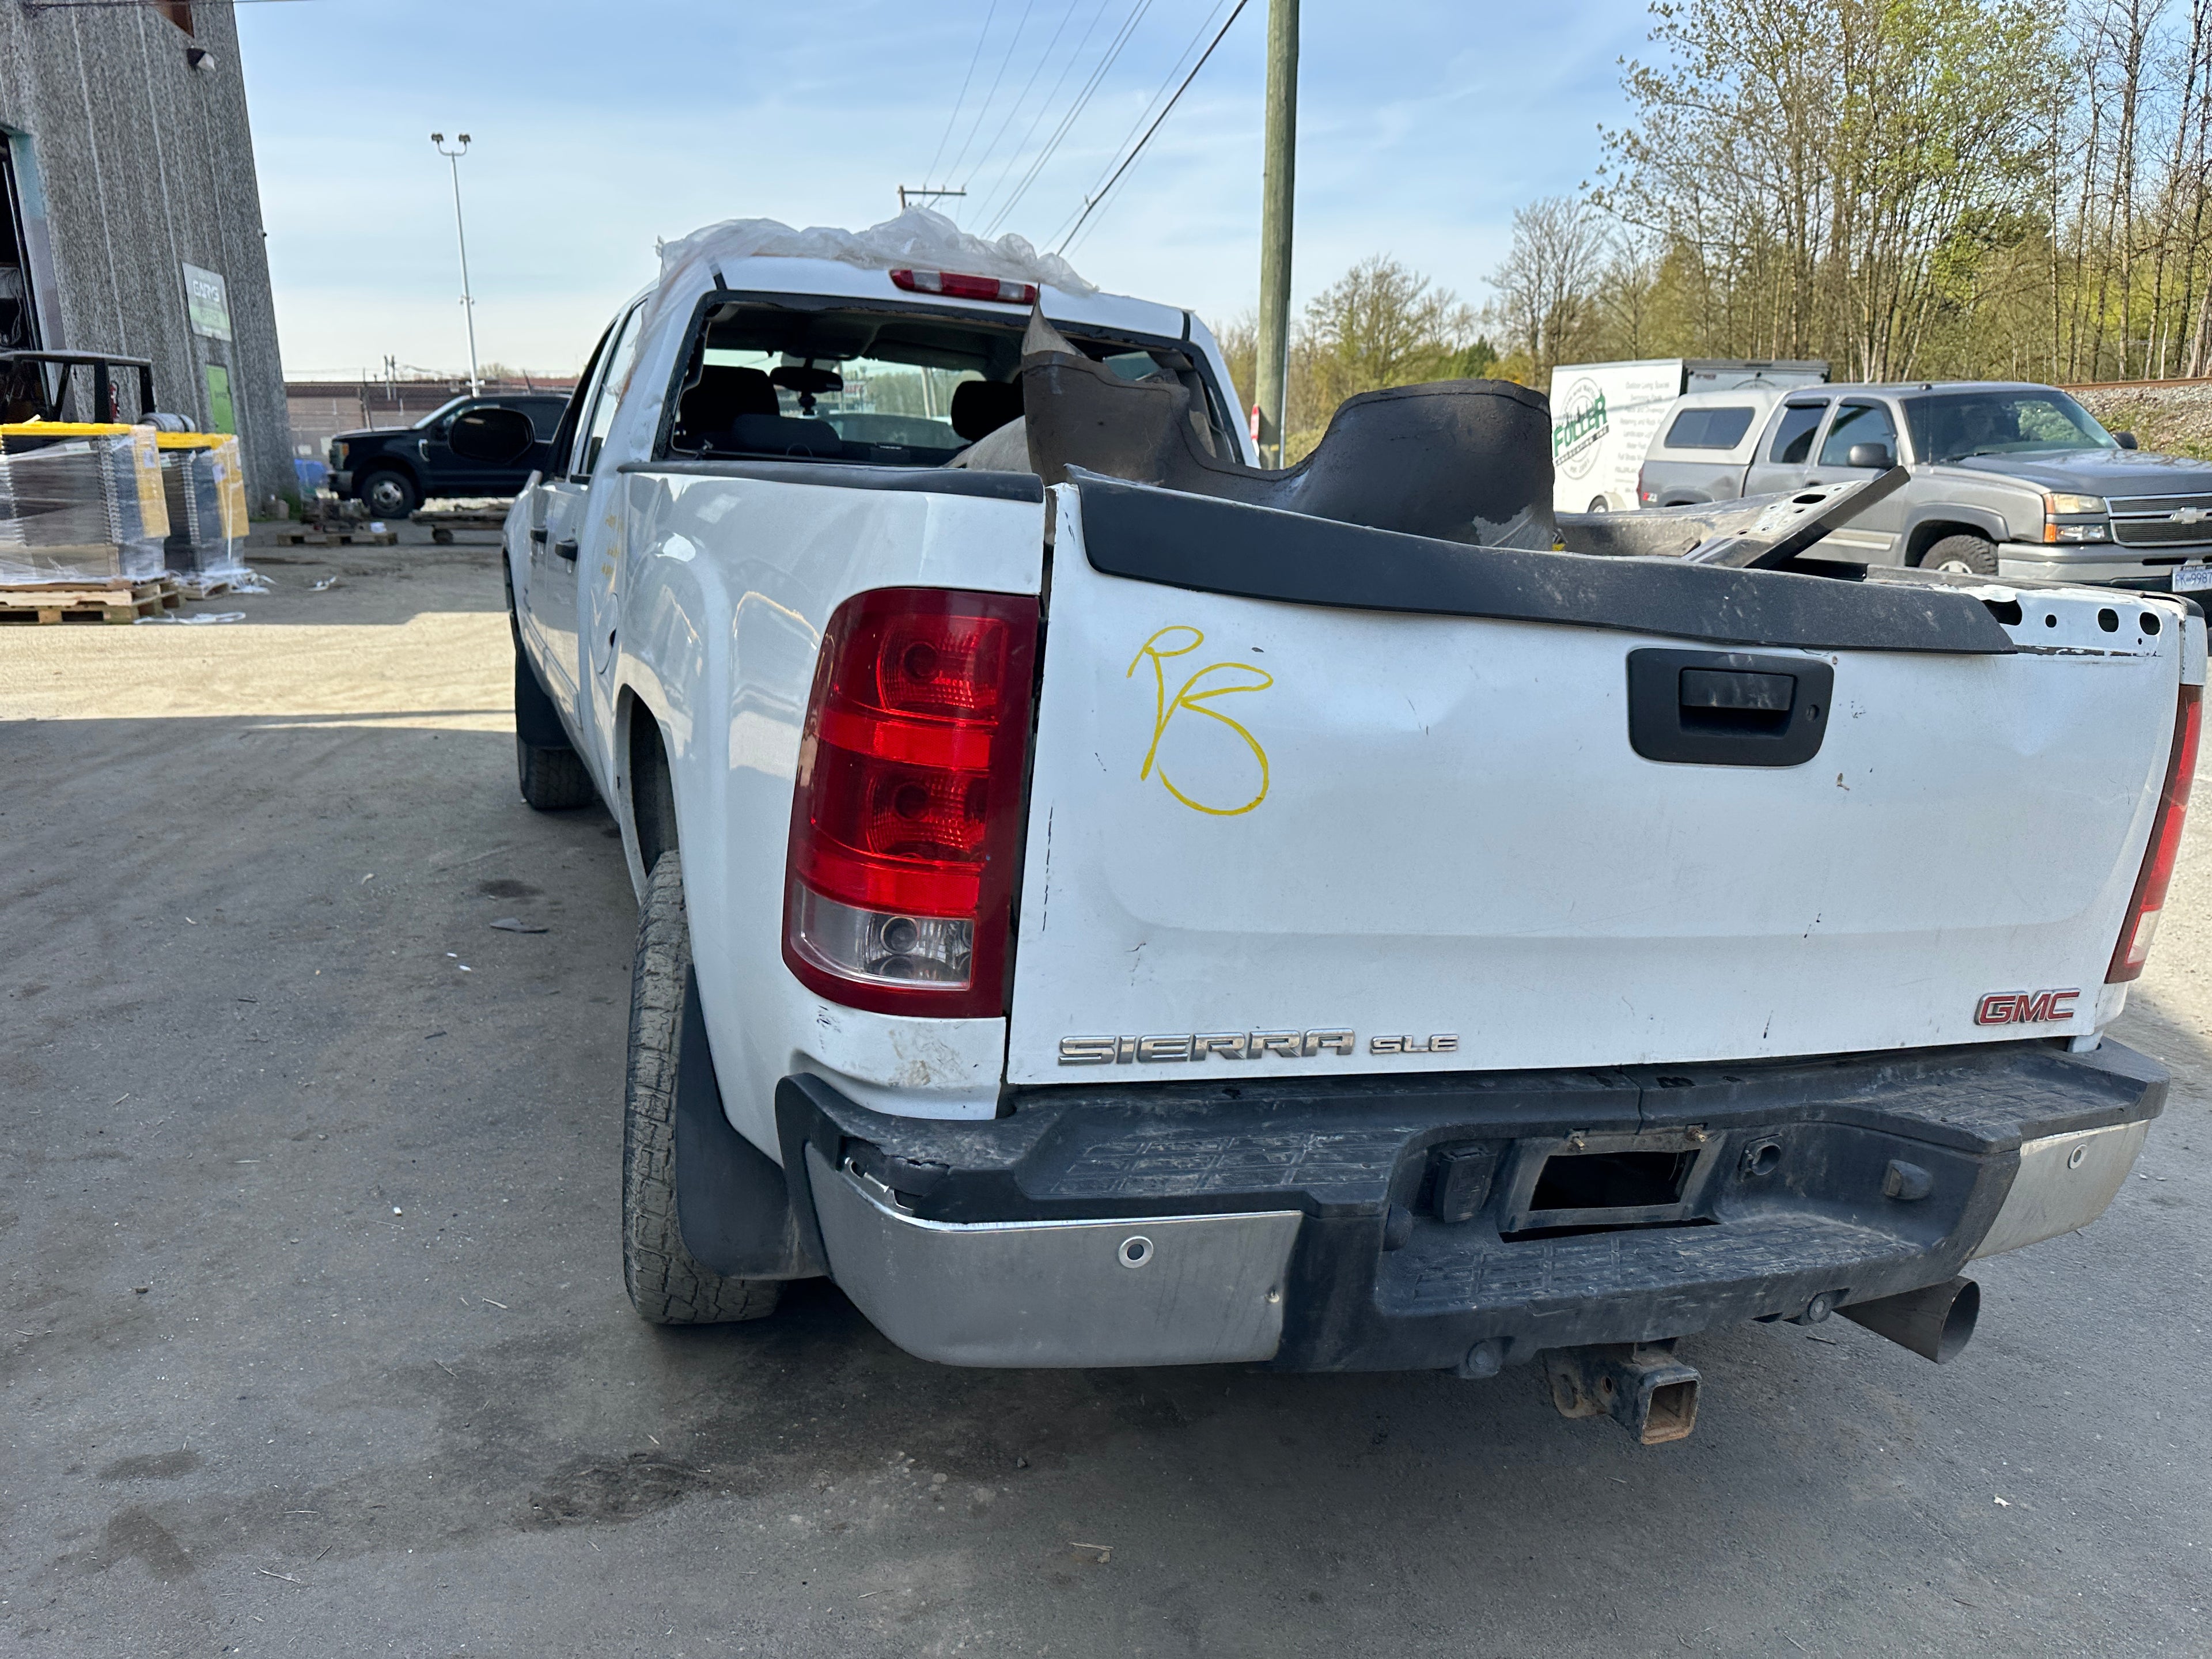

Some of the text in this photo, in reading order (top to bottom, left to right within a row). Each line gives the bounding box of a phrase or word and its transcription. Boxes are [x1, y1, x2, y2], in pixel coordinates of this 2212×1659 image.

[1554, 394, 1608, 459] FULLER
[1974, 987, 2082, 1026] GMC
[1058, 1028, 1459, 1066] SIERRA SLE
